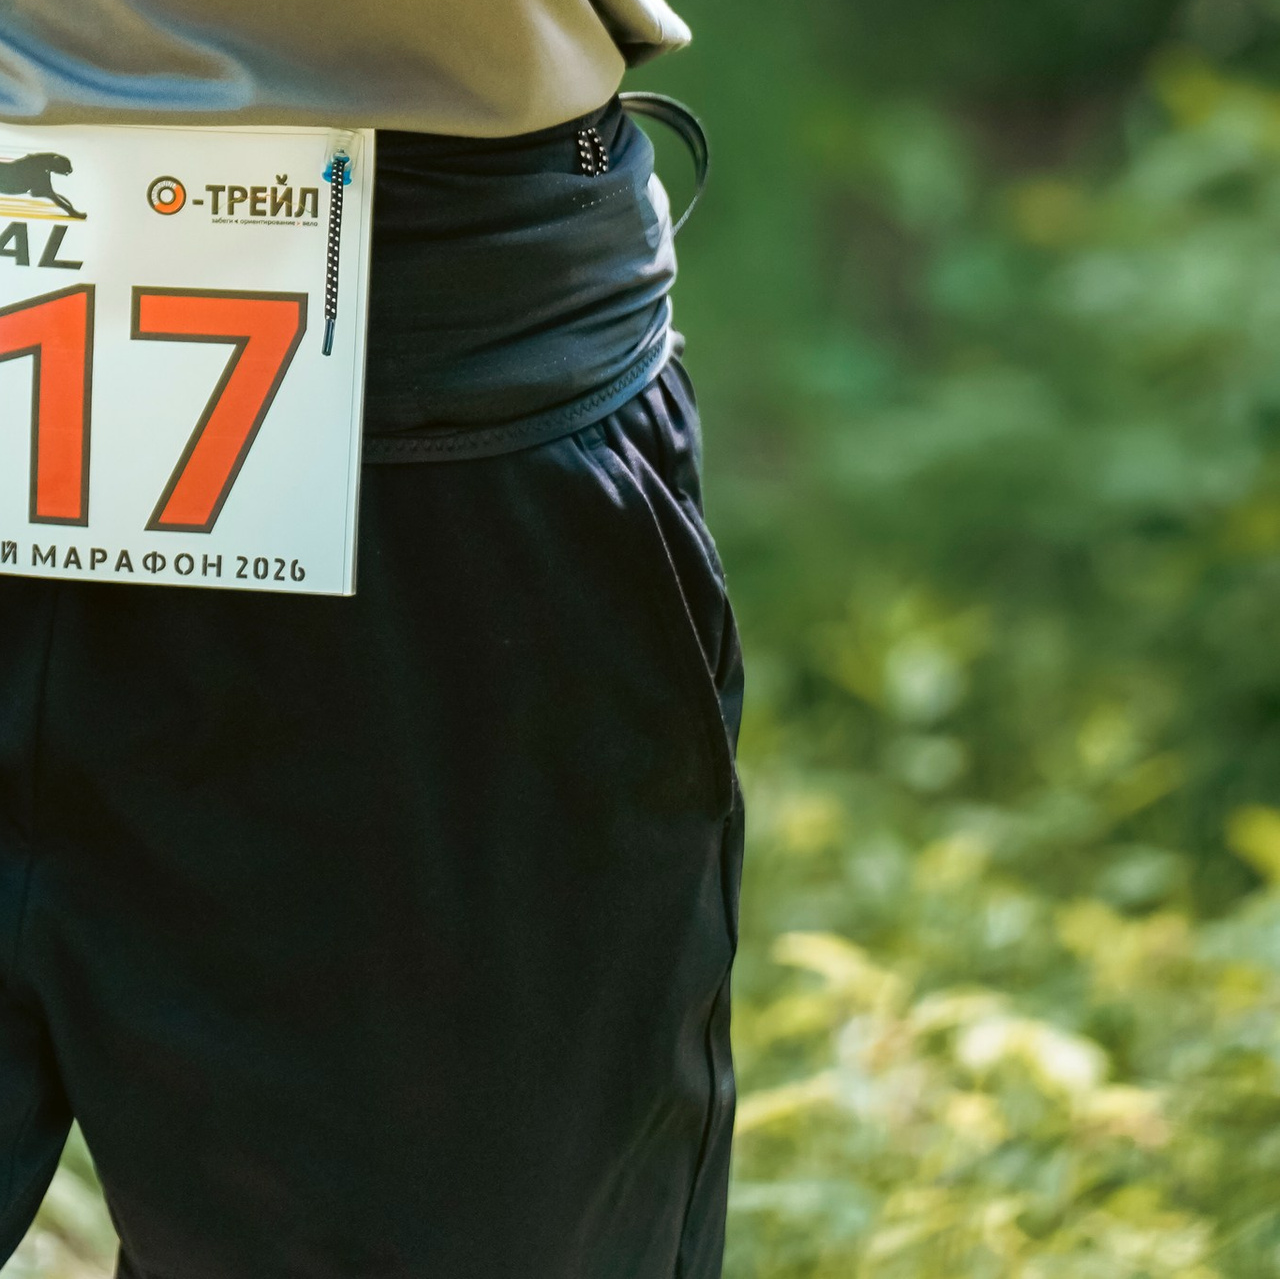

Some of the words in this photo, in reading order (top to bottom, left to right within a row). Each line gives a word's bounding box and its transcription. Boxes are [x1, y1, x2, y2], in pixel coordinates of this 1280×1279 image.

[239, 218, 296, 227] ориентирование
[31, 543, 223, 579] МАРАФОН
[235, 555, 307, 582] 2026
